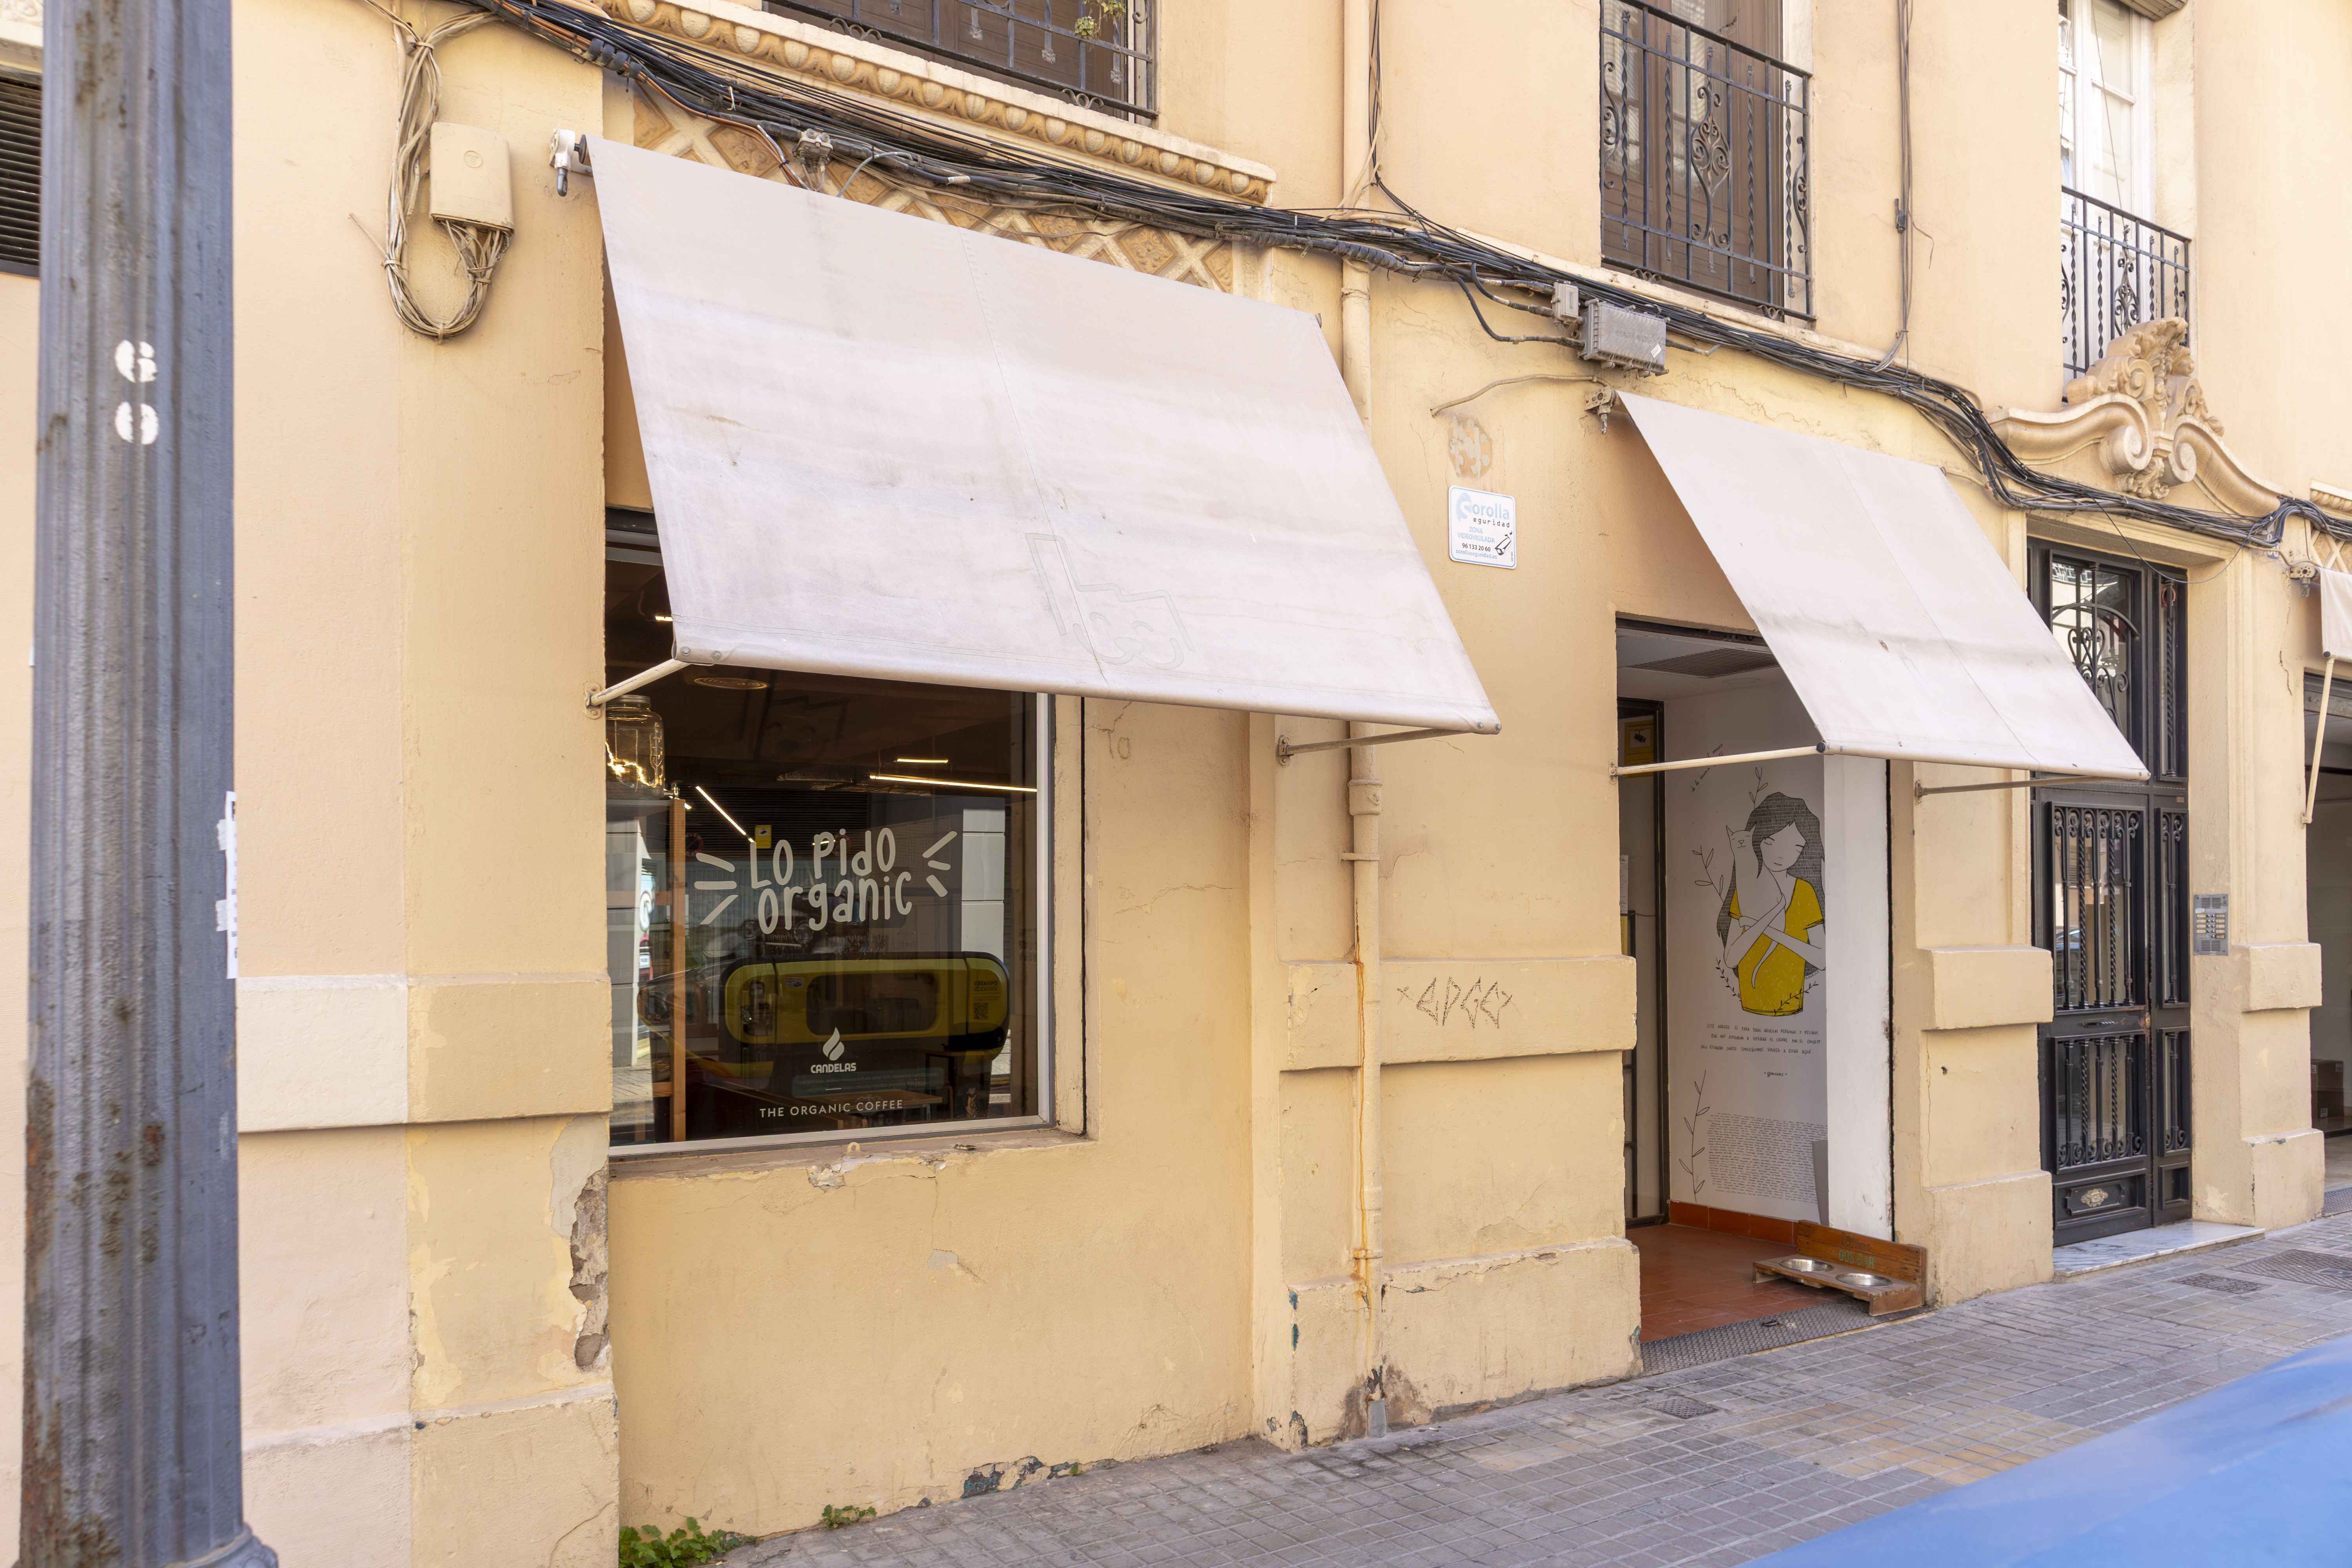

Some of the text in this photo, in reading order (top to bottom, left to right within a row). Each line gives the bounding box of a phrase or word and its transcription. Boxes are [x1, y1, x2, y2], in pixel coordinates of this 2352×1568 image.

[1457, 533, 1495, 543] VIDEOVIGILADA
[1456, 549, 1497, 559] sorollaseguridad.es
[811, 1062, 857, 1074] CANDELAS
[760, 1100, 903, 1118] THE ORGANIC COFFEE
